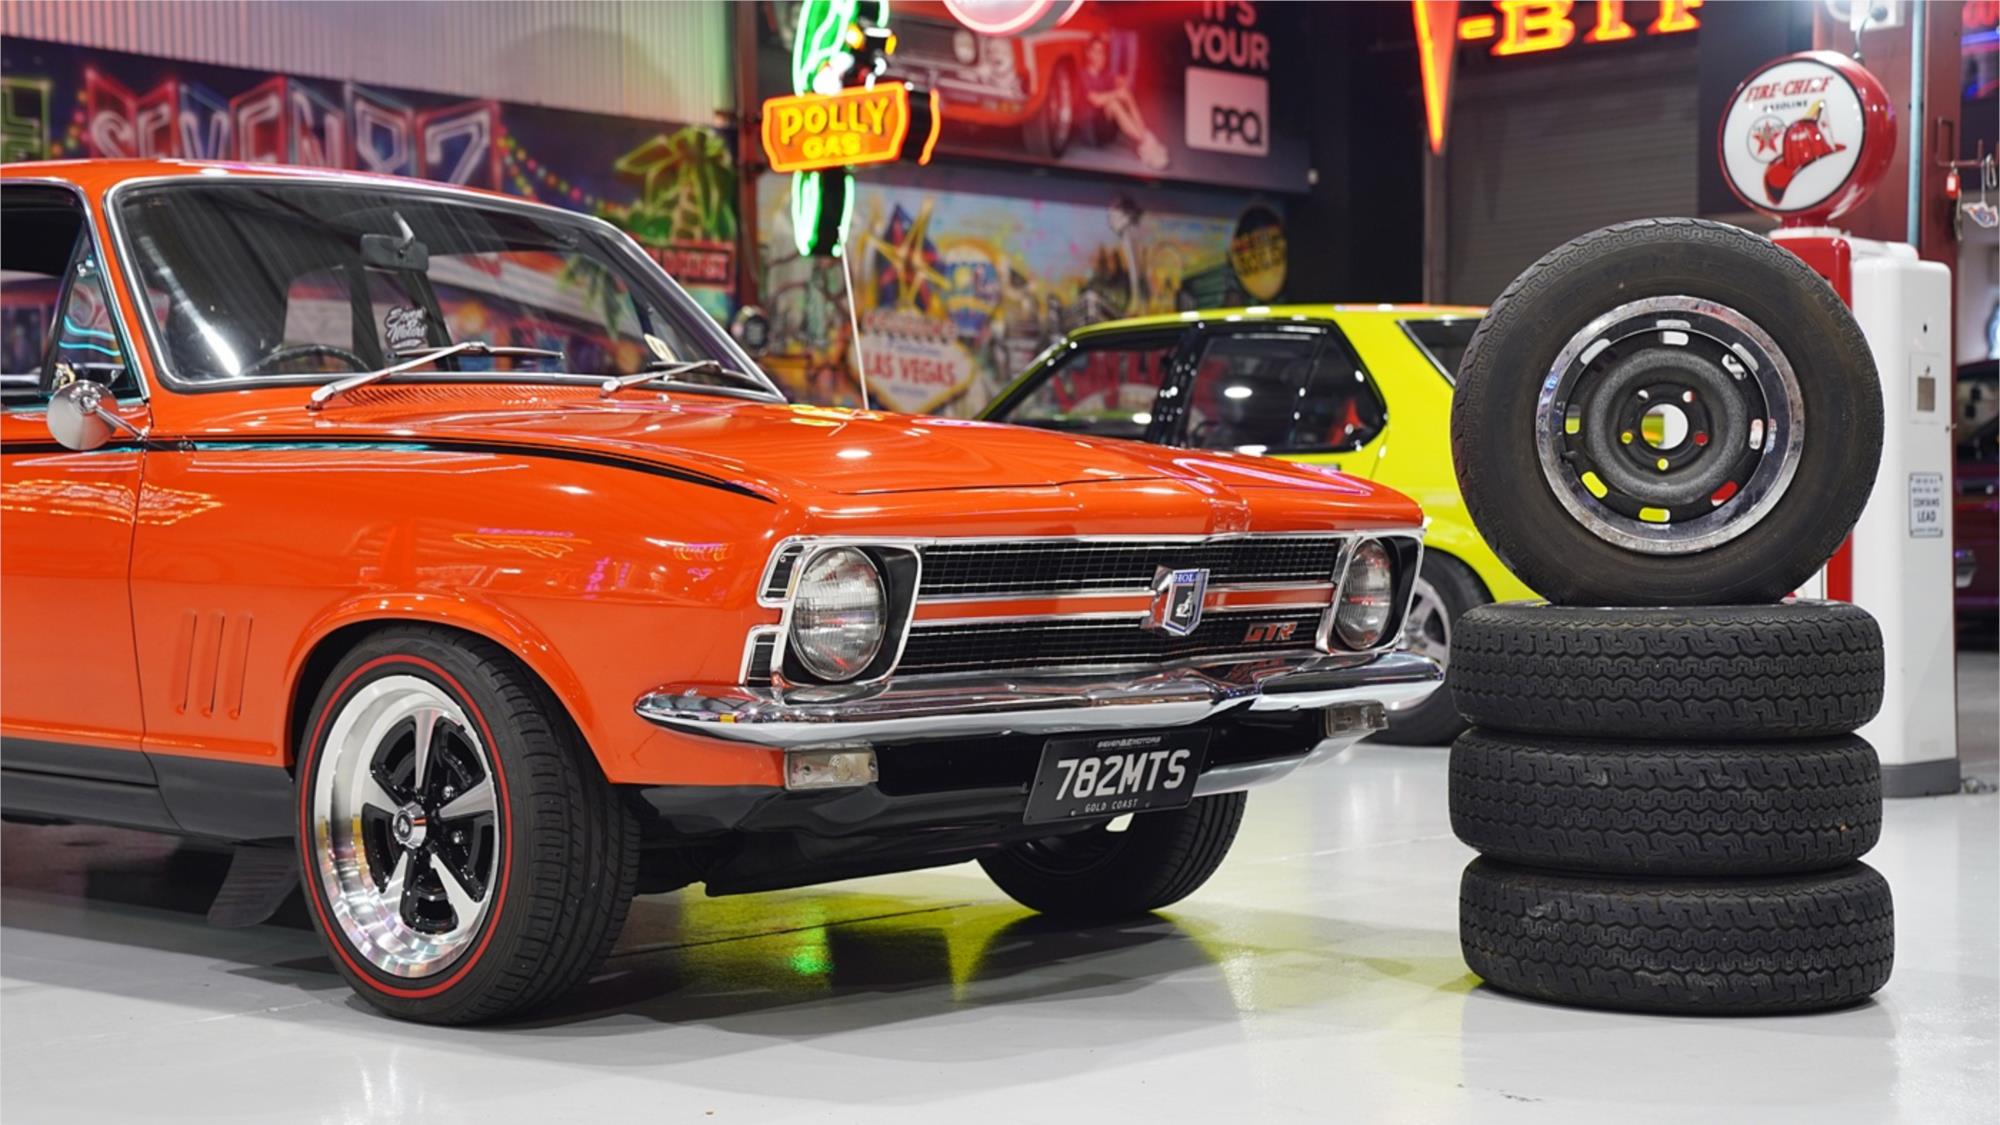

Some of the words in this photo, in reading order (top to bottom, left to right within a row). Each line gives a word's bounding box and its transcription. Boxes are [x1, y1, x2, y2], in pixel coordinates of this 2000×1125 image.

[1184, 19, 1269, 70] YOUR
[780, 96, 889, 145] POLLY
[1211, 104, 1262, 147] PPQ
[802, 132, 861, 160] GAS
[863, 352, 892, 379] LAS
[899, 356, 957, 385] VEGAS
[1916, 510, 1936, 522] LEAD
[1242, 621, 1298, 643] GTR
[1056, 749, 1190, 801] 782MTS
[1085, 802, 1107, 813] GOLD
[1111, 798, 1138, 810] COAST
